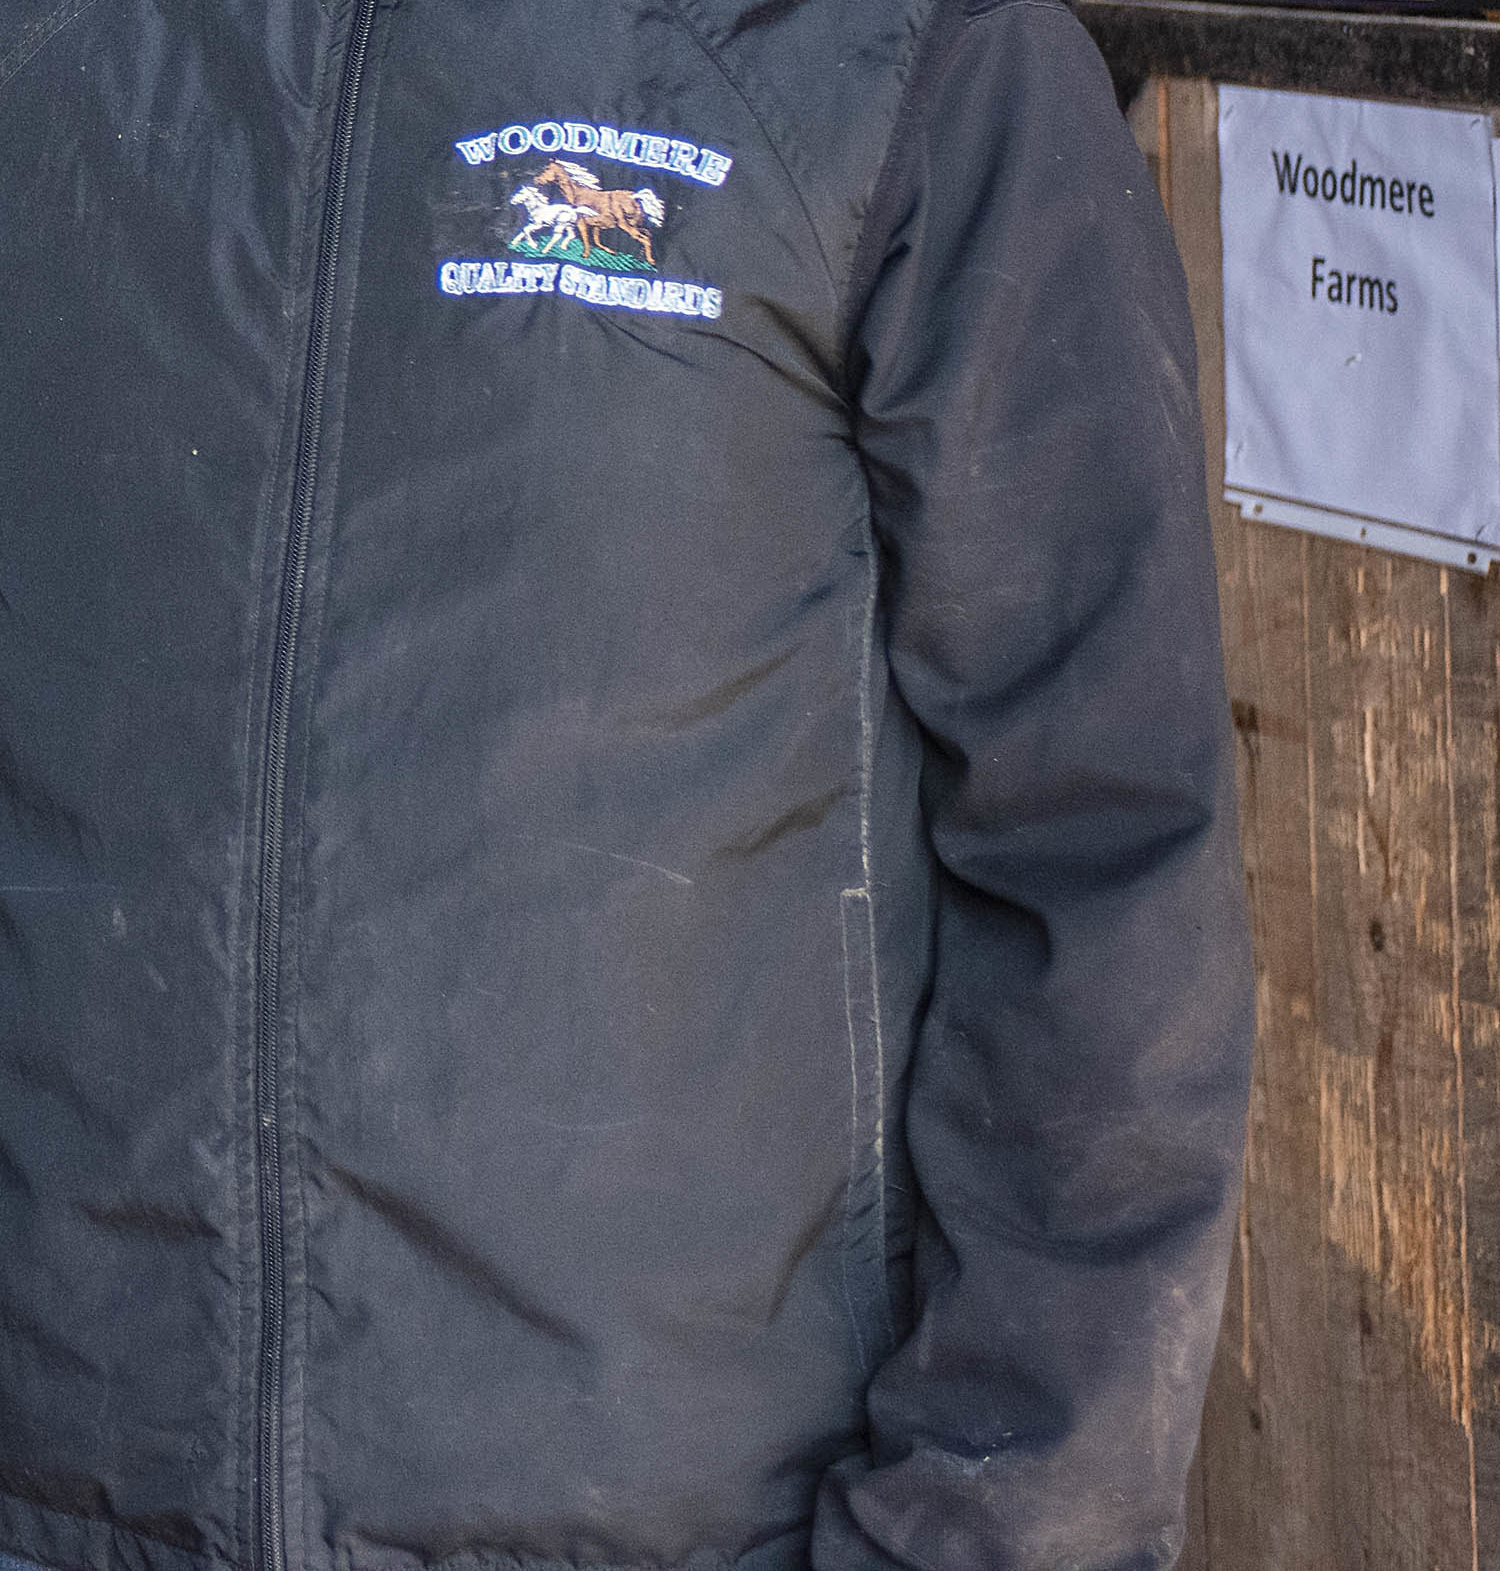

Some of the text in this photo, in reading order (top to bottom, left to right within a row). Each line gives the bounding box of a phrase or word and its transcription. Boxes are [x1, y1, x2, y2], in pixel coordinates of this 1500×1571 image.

[456, 121, 734, 187] WOODMERE
[1272, 150, 1435, 218] Woodmere
[440, 261, 723, 320] QUALITY STANDARDS
[1311, 257, 1399, 314] Farms
